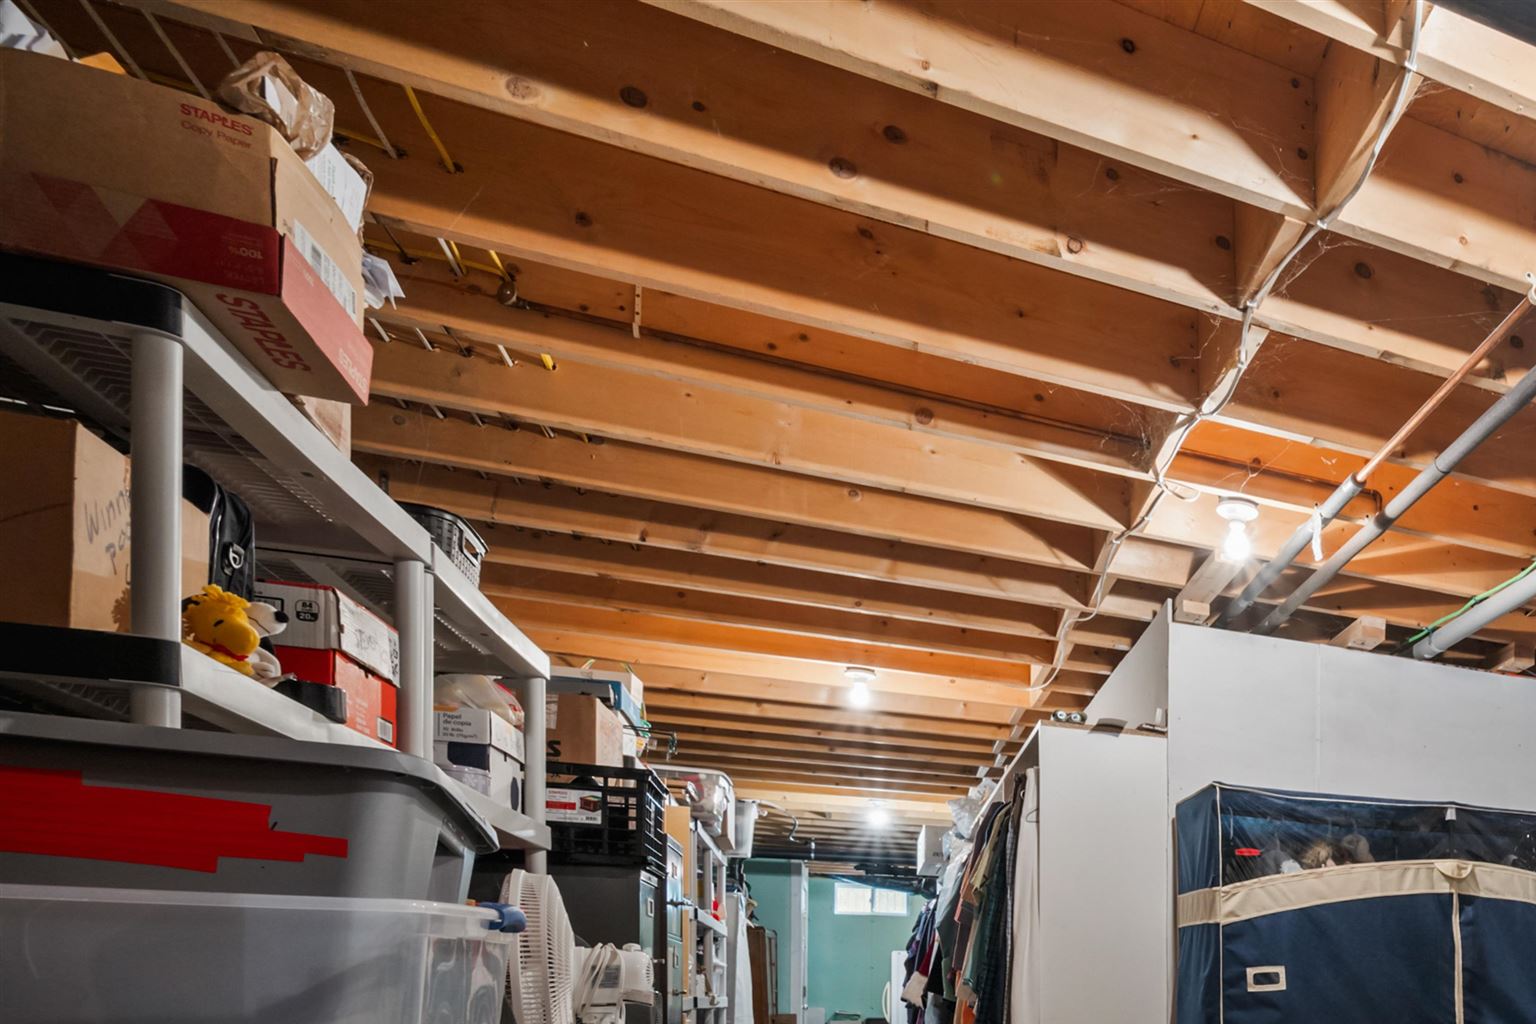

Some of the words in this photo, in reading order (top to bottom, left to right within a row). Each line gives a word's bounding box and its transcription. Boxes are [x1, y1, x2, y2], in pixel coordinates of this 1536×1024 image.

[180, 103, 253, 136] STAPLES
[180, 121, 213, 137] Copy
[216, 130, 252, 149] Paper
[215, 292, 312, 373] STAPLES
